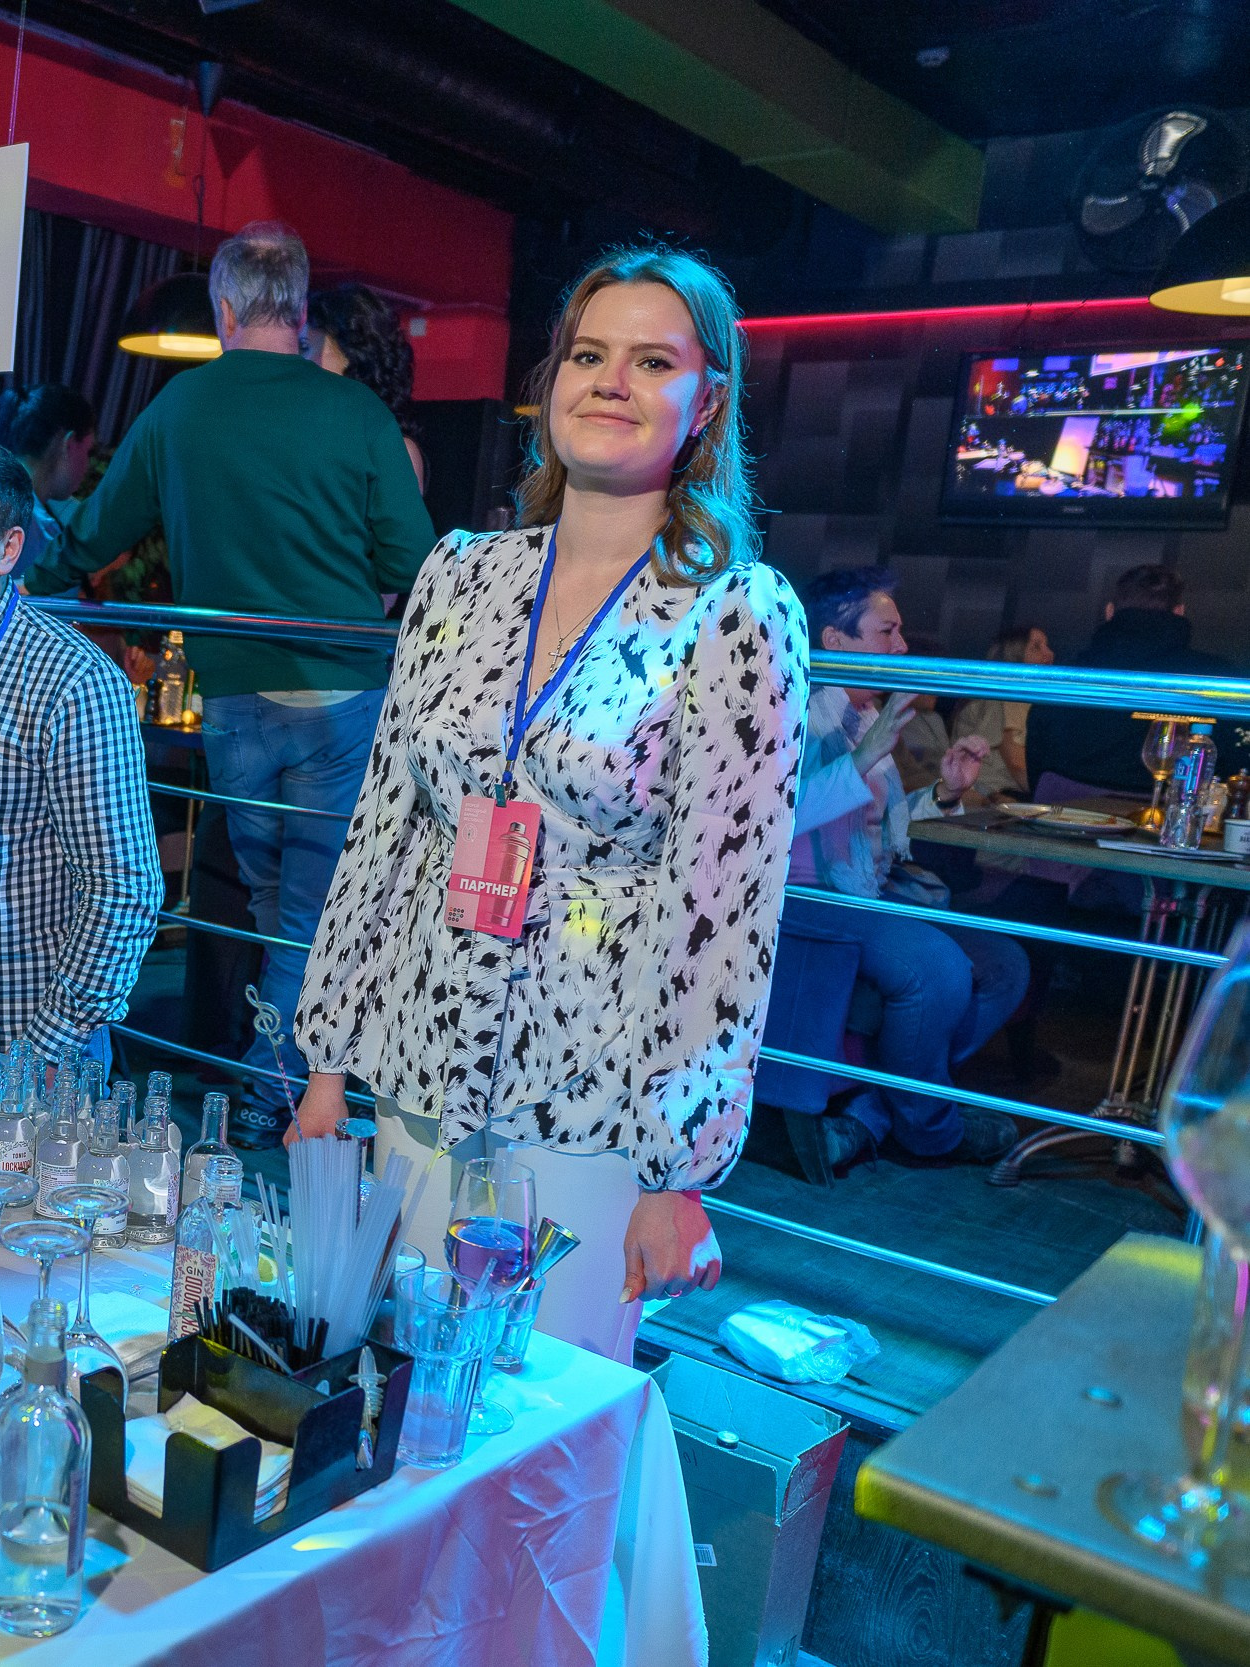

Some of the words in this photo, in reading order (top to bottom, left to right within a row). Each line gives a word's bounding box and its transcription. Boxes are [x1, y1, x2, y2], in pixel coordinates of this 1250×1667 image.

[459, 877, 519, 898] ПАРТНЕР
[240, 1108, 278, 1128] ecco
[12, 1151, 27, 1159] TONIC
[186, 1265, 204, 1277] GIN
